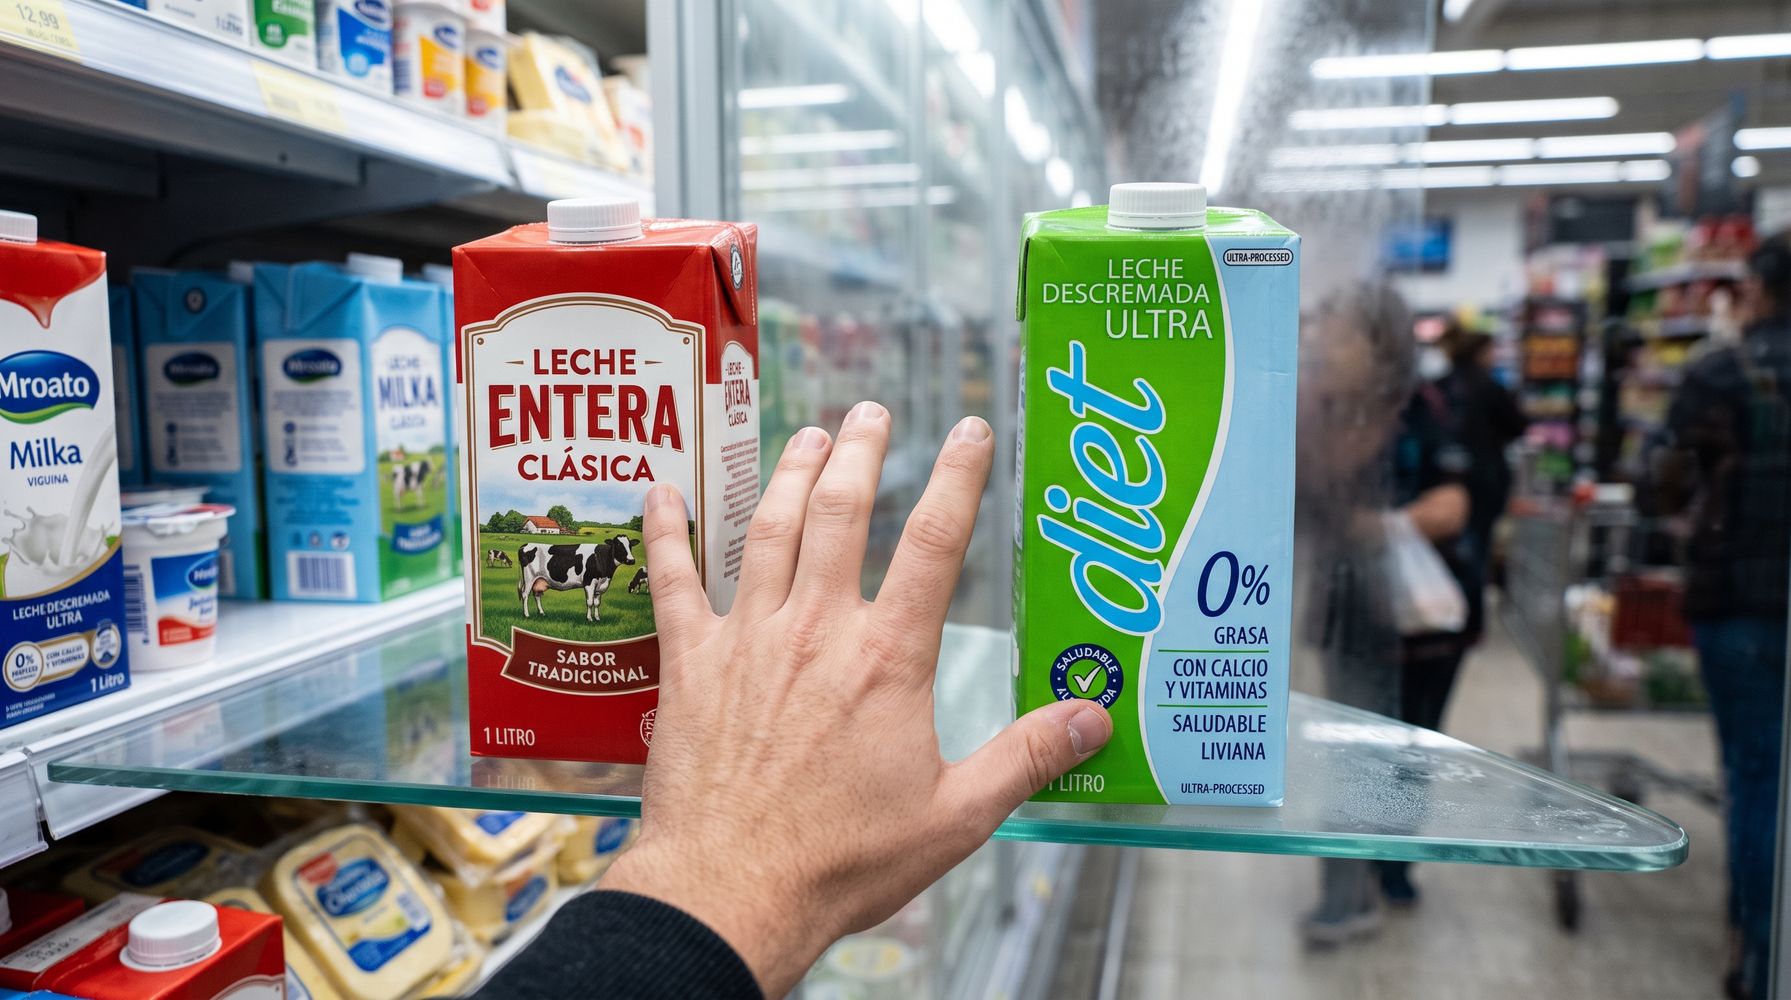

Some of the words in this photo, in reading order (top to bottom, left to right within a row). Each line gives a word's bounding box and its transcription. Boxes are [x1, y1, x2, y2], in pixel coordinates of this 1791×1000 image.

[16, 3, 59, 29] 12,99
[1226, 252, 1290, 262] ULTRA-PROCESSED
[1108, 259, 1184, 279] LECHE
[1043, 284, 1210, 304] DESCREMADA
[1106, 309, 1214, 339] ULTRA
[533, 348, 637, 376] LECHE
[727, 362, 742, 376] LECHE
[0, 371, 90, 398] Mroato
[724, 379, 752, 413] ENTERA
[488, 384, 685, 453] ENTERA
[10, 437, 83, 470] Milka
[517, 446, 655, 481] CLÁSICA
[27, 474, 69, 487] VIGUINA
[1037, 340, 1166, 636] diet
[1197, 551, 1270, 617] 0%
[13, 603, 47, 620] LECHE
[47, 589, 110, 614] DESCREMADA
[47, 610, 83, 629] ULTRA
[1214, 626, 1269, 645] GRASA
[15, 652, 35, 668] 0%
[557, 649, 616, 666] SABOR
[1056, 647, 1118, 673] SALUDABLE
[528, 661, 649, 685] TRADICIONAL
[1173, 658, 1209, 677] CON
[1212, 658, 1268, 678] CALCIO
[90, 678, 97, 693] 1
[99, 672, 126, 691] Litro
[1165, 681, 1176, 699] Y
[1180, 681, 1267, 700] VITAMINAS
[1172, 714, 1266, 733] SALUDABLE
[483, 727, 491, 745] 1
[496, 727, 536, 746] LITRO
[1201, 742, 1266, 760] LIVIANA
[1060, 774, 1105, 793] LITRO
[1180, 783, 1265, 795] ULTRA-PROCESSED
